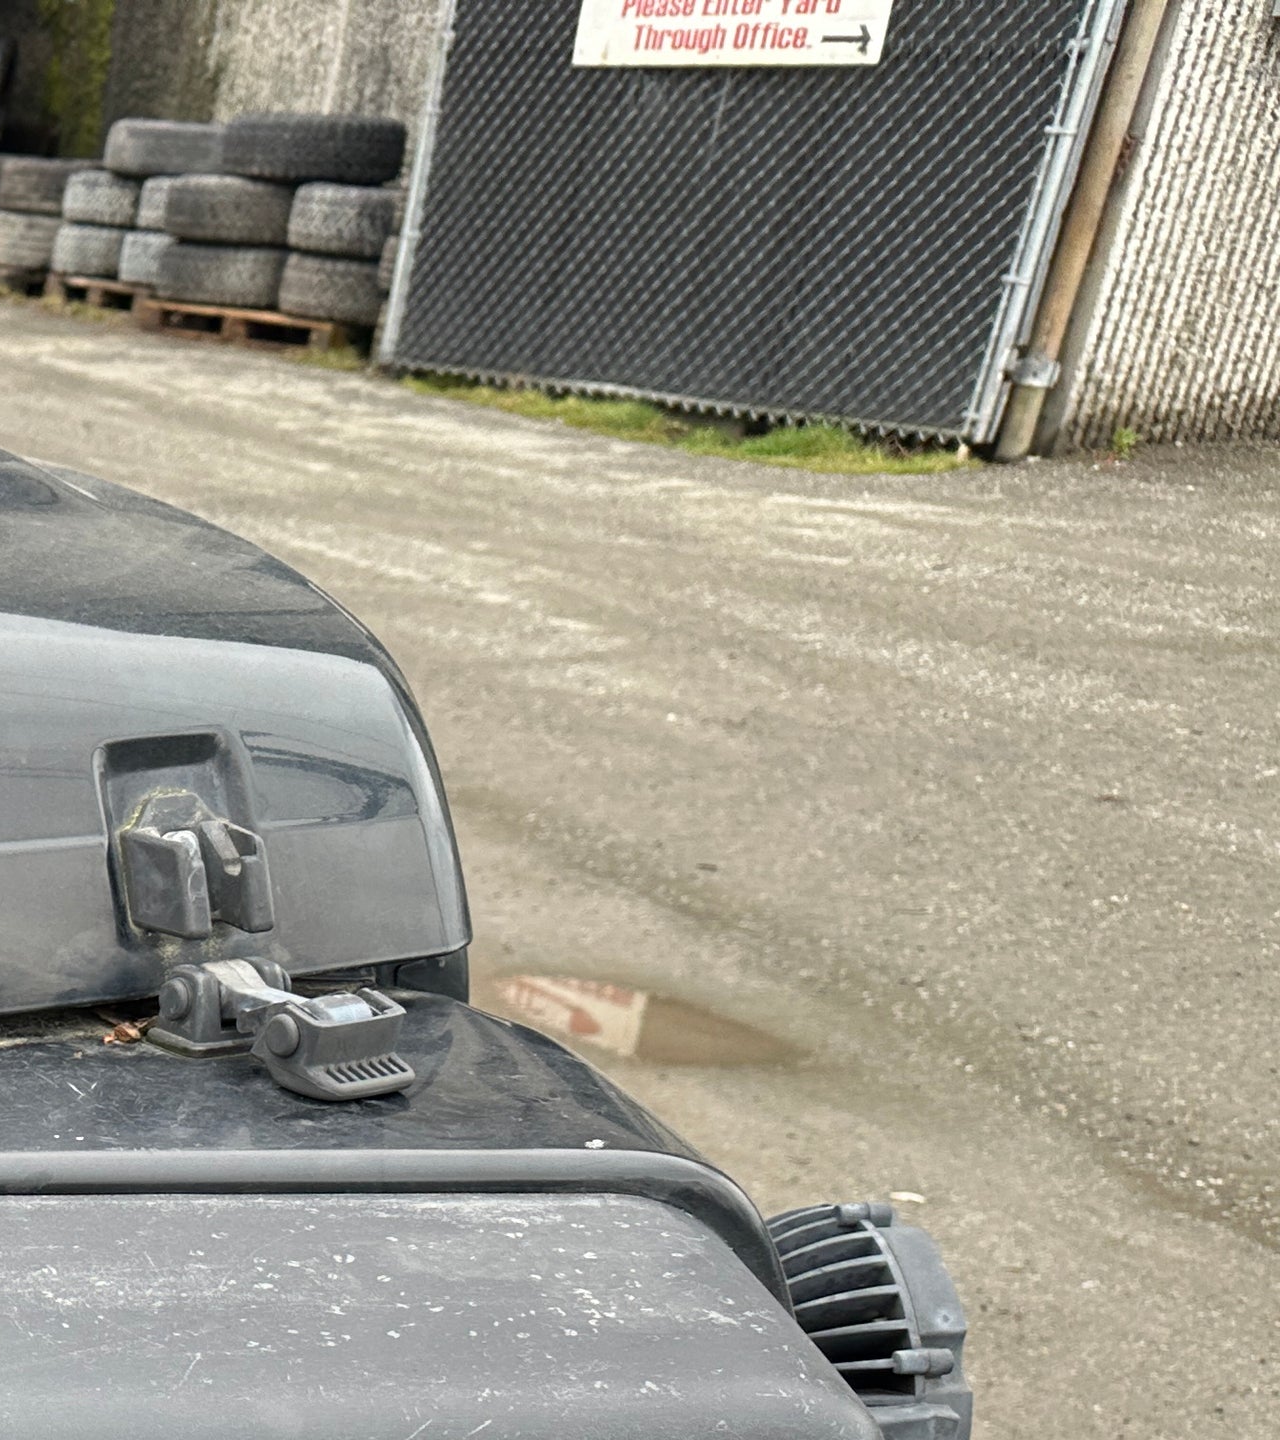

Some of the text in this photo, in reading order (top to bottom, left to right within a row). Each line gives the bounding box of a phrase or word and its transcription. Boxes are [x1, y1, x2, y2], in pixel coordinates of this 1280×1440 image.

[621, 0, 841, 17] Please Enter Yard
[633, 22, 813, 54] Through Office.
